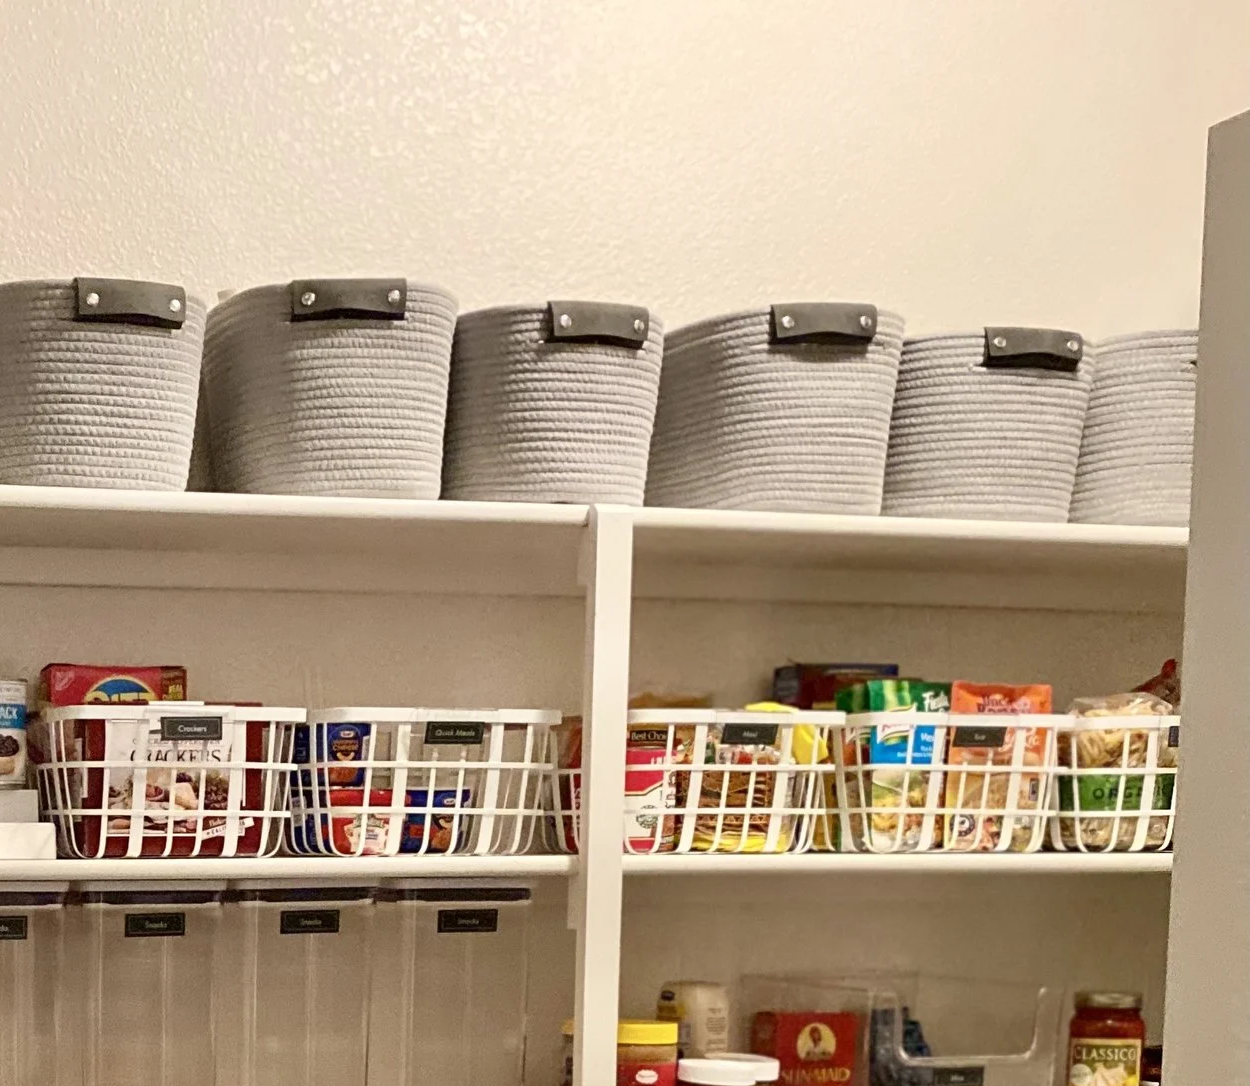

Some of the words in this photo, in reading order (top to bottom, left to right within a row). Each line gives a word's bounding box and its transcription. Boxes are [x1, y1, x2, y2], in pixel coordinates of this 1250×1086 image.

[177, 724, 208, 733] Crackers
[435, 728, 455, 738] Quick
[631, 731, 649, 741] Best
[1074, 1046, 1137, 1061] CLASSICO
